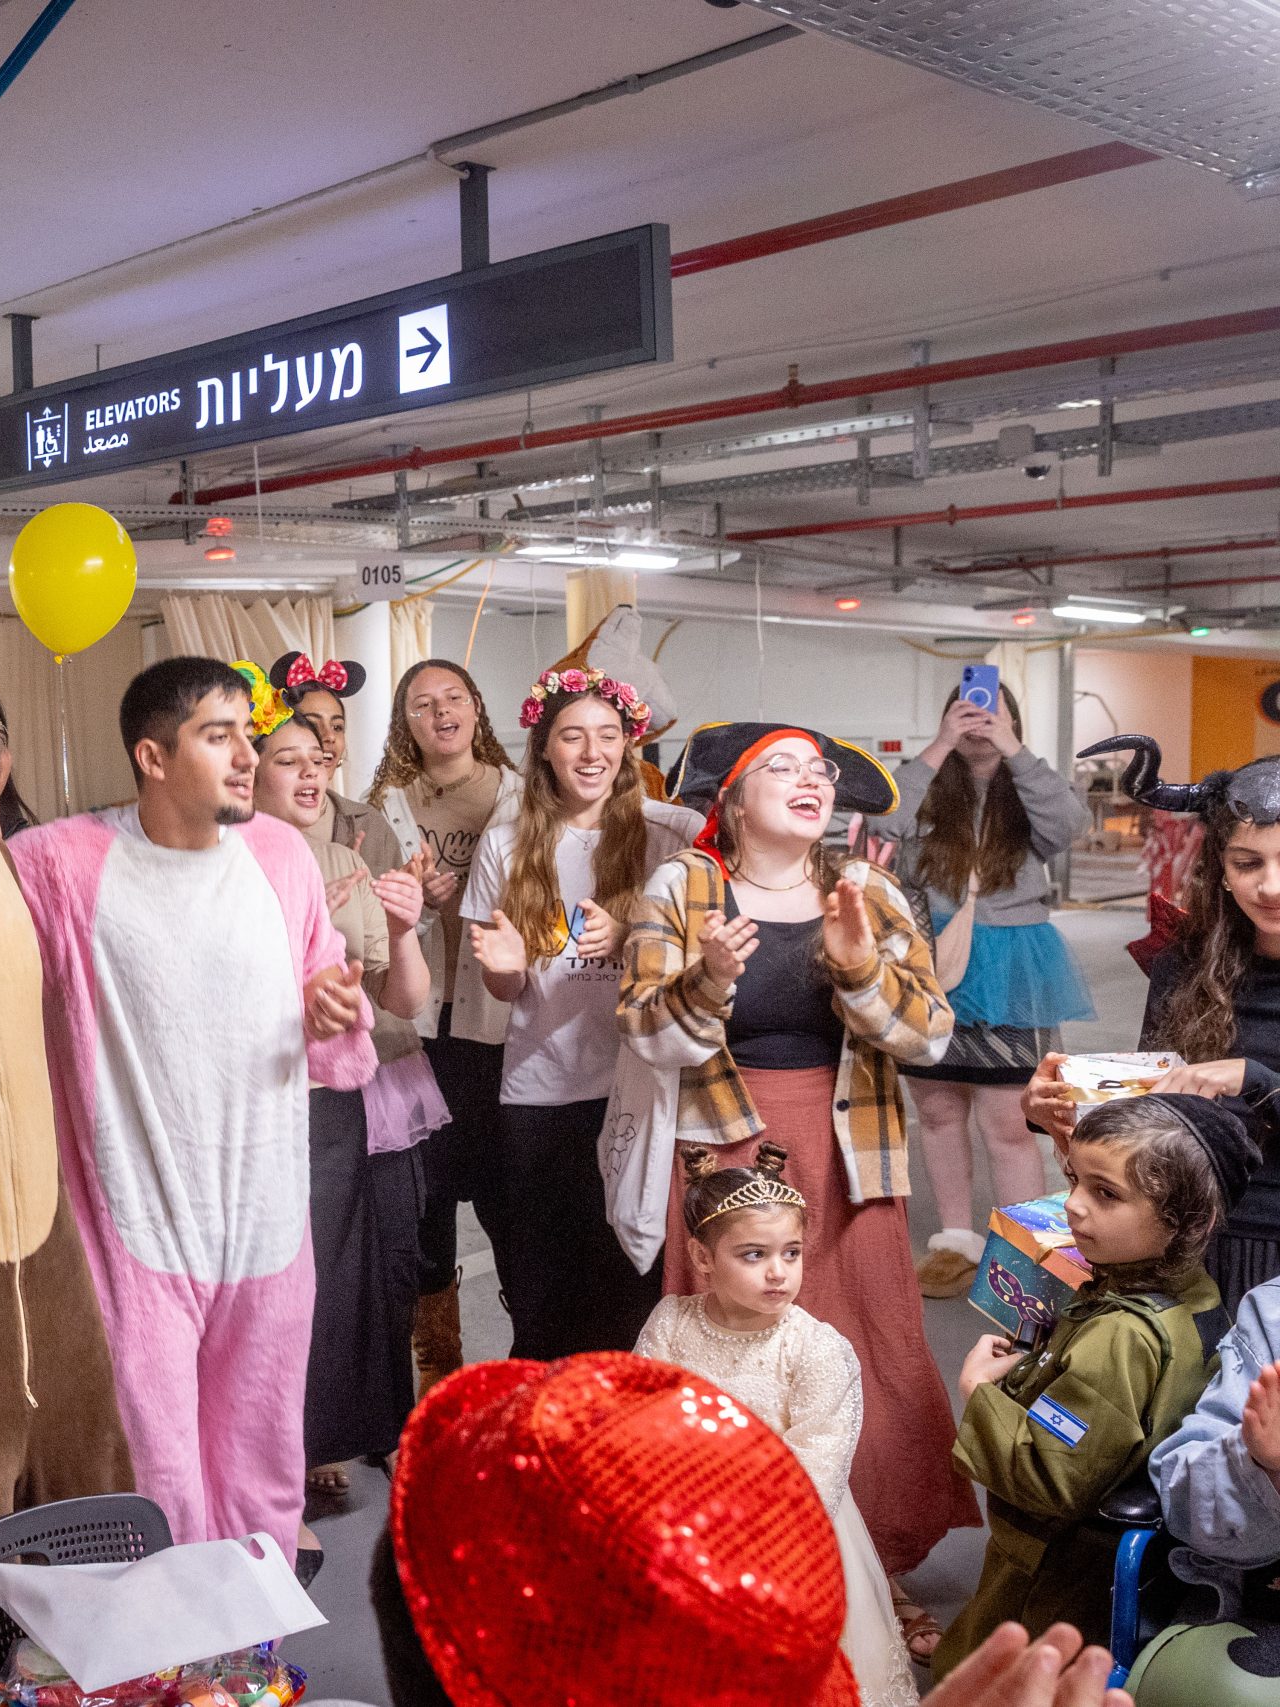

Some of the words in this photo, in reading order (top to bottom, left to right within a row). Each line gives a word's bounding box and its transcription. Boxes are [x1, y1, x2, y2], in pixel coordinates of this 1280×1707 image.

[195, 342, 363, 430] מעליות
[85, 388, 181, 431] ELEVATORS
[83, 433, 129, 455] مصعد
[362, 565, 401, 585] 0105
